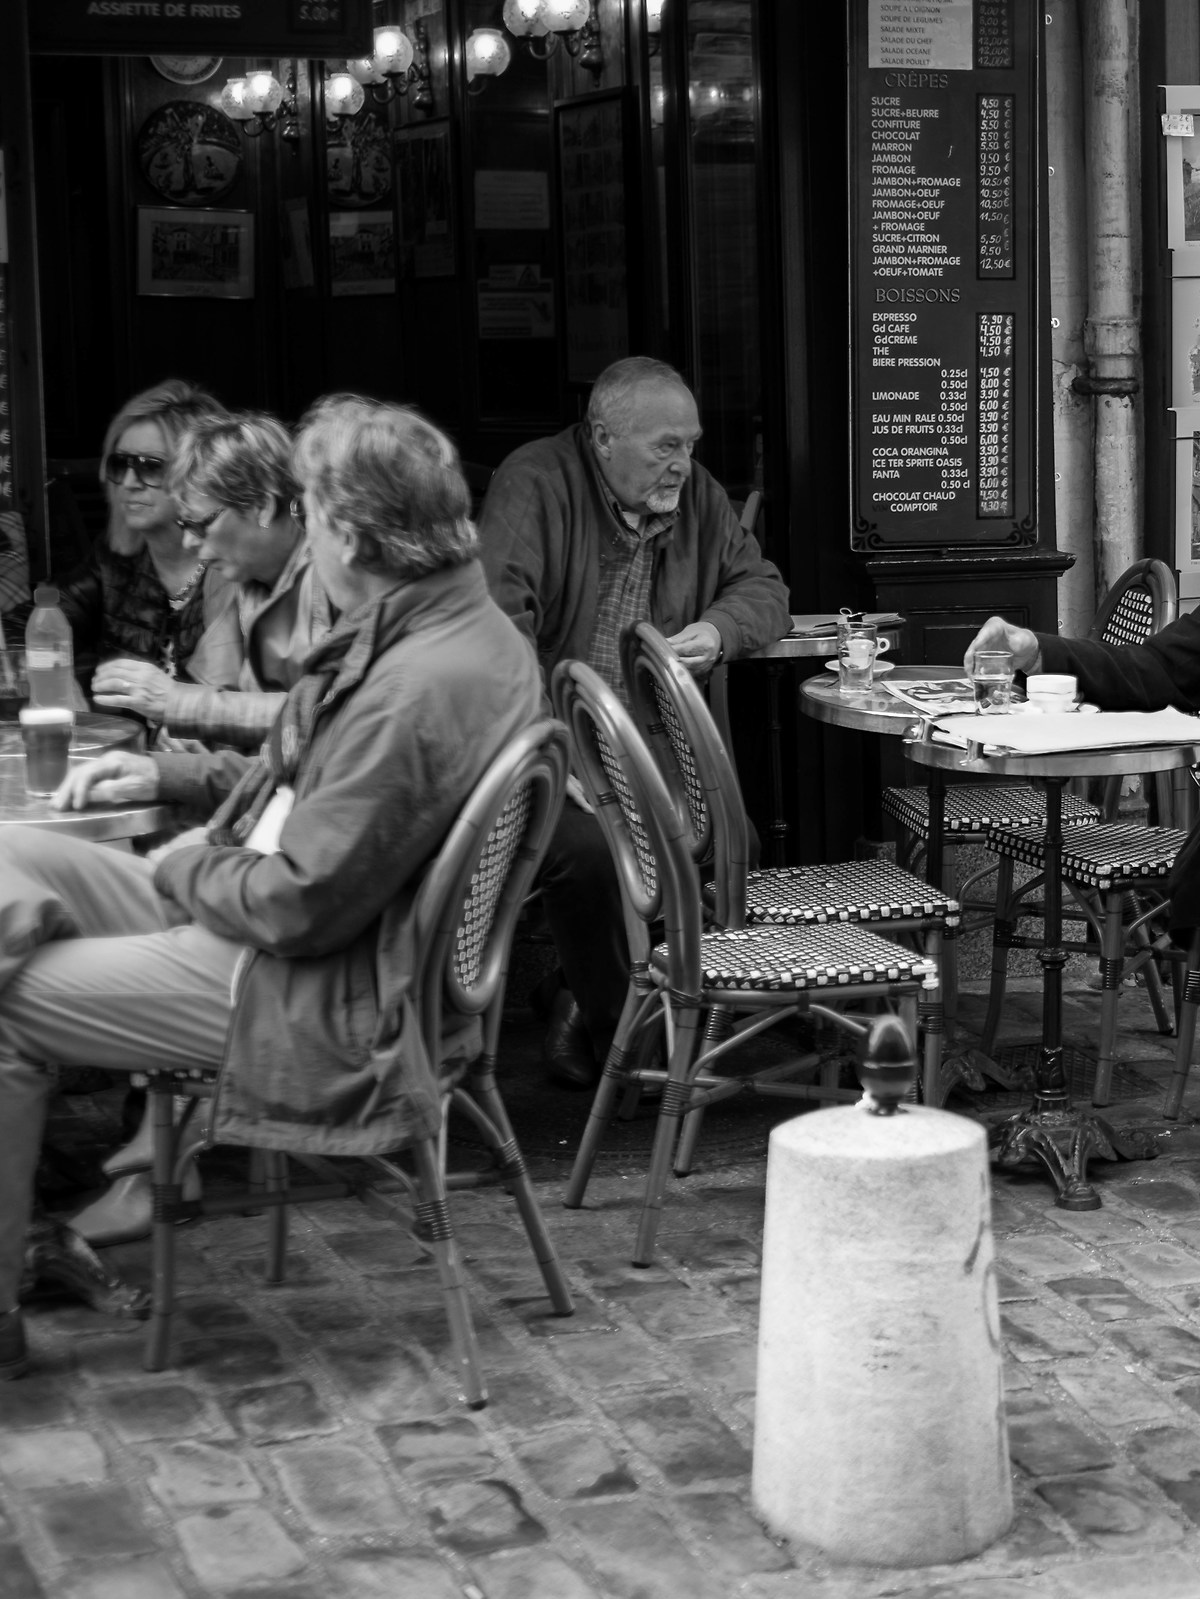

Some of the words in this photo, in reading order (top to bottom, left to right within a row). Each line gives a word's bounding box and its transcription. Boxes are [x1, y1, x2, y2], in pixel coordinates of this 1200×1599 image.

[87, 2, 160, 16] ASSIETTE
[165, 4, 186, 17] DE
[191, 4, 241, 18] FRITES
[885, 71, 948, 88] CRÊPES
[872, 97, 900, 106] SUCRE
[872, 109, 939, 118] SUCRE+BEURRE
[872, 120, 920, 129] CONFITURE
[872, 131, 920, 140] CHOCOLAT
[872, 143, 912, 151] MARRON
[872, 155, 911, 163] JAMBON
[872, 166, 916, 174] FROMAGE
[872, 177, 961, 186] JAMBON+FROMAGE
[872, 189, 940, 197] JAMBON+OEUF
[872, 200, 945, 209] FROMAGE+OEUF
[872, 212, 940, 220] JAMBON+OEUF
[881, 223, 925, 231] FROMAGE
[873, 234, 939, 243] SUCRE+CITRON
[873, 245, 905, 254] GRAND
[908, 245, 947, 254] MARNIER
[872, 257, 961, 266] JAMBON+FROMAGE
[873, 268, 943, 277] +OEUF+TOMATE
[876, 288, 960, 303] BOISSONS
[873, 313, 917, 322] EXPRESSO
[873, 324, 885, 333] Gd
[888, 324, 910, 333] CAFE
[873, 347, 889, 355] THE
[873, 358, 895, 367] BIERE
[898, 358, 940, 367] PRESSION
[941, 369, 968, 378] 0.25cl
[941, 380, 968, 389] 0.50cl
[873, 392, 919, 400] LIMONADE
[940, 391, 966, 400] 0.33cl
[941, 403, 968, 411] 0.50cl
[873, 414, 890, 423] EAU
[893, 414, 911, 423] MIN
[915, 414, 936, 423] RALE
[938, 414, 964, 423] 0.50cl
[872, 425, 889, 434] JUS
[891, 425, 903, 434] DE
[905, 425, 934, 434] FRUITS
[936, 425, 963, 433] 0.33cl
[941, 436, 968, 444] 0.50cl
[873, 448, 898, 456] COCA
[901, 448, 948, 456] ORANGINA
[873, 459, 886, 467] ICE
[888, 459, 903, 467] TER
[906, 459, 934, 467] SPRITE
[936, 459, 962, 467] OASIS
[873, 470, 900, 479] FANTA
[941, 469, 968, 478] 0.33cl
[941, 481, 961, 489] 0.50
[963, 480, 970, 489] cl
[873, 492, 920, 501] CHOCOLAT
[923, 491, 955, 500] CHAUD
[891, 503, 937, 513] COMPTOIR
